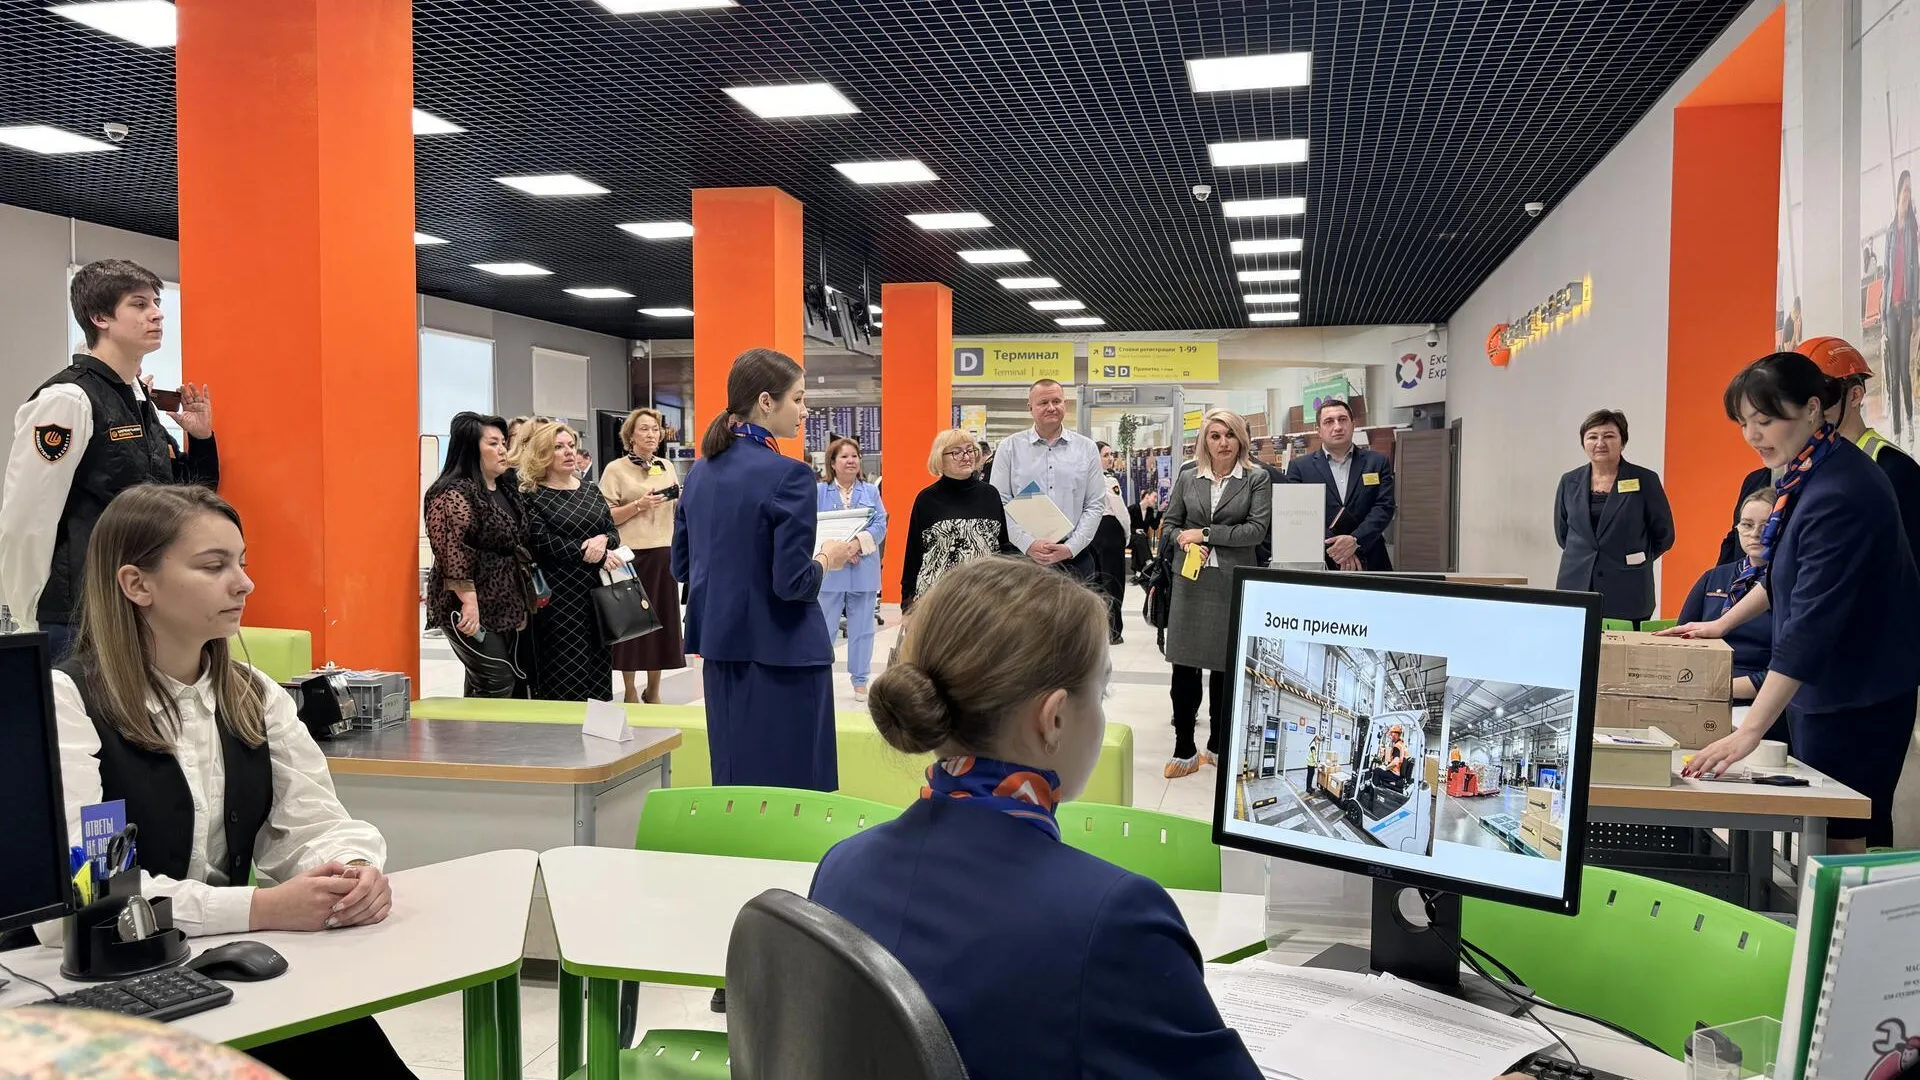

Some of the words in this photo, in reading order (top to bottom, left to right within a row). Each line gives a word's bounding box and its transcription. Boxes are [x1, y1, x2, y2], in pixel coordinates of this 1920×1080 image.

[960, 352, 978, 372] D
[993, 350, 1059, 362] Терминал
[993, 368, 1026, 377] Terminal
[1120, 367, 1129, 376] D
[1428, 367, 1447, 380] Exp
[1264, 611, 1299, 630] Зона
[1303, 618, 1368, 638] приемки
[85, 816, 114, 838] ОТВЕТЫ
